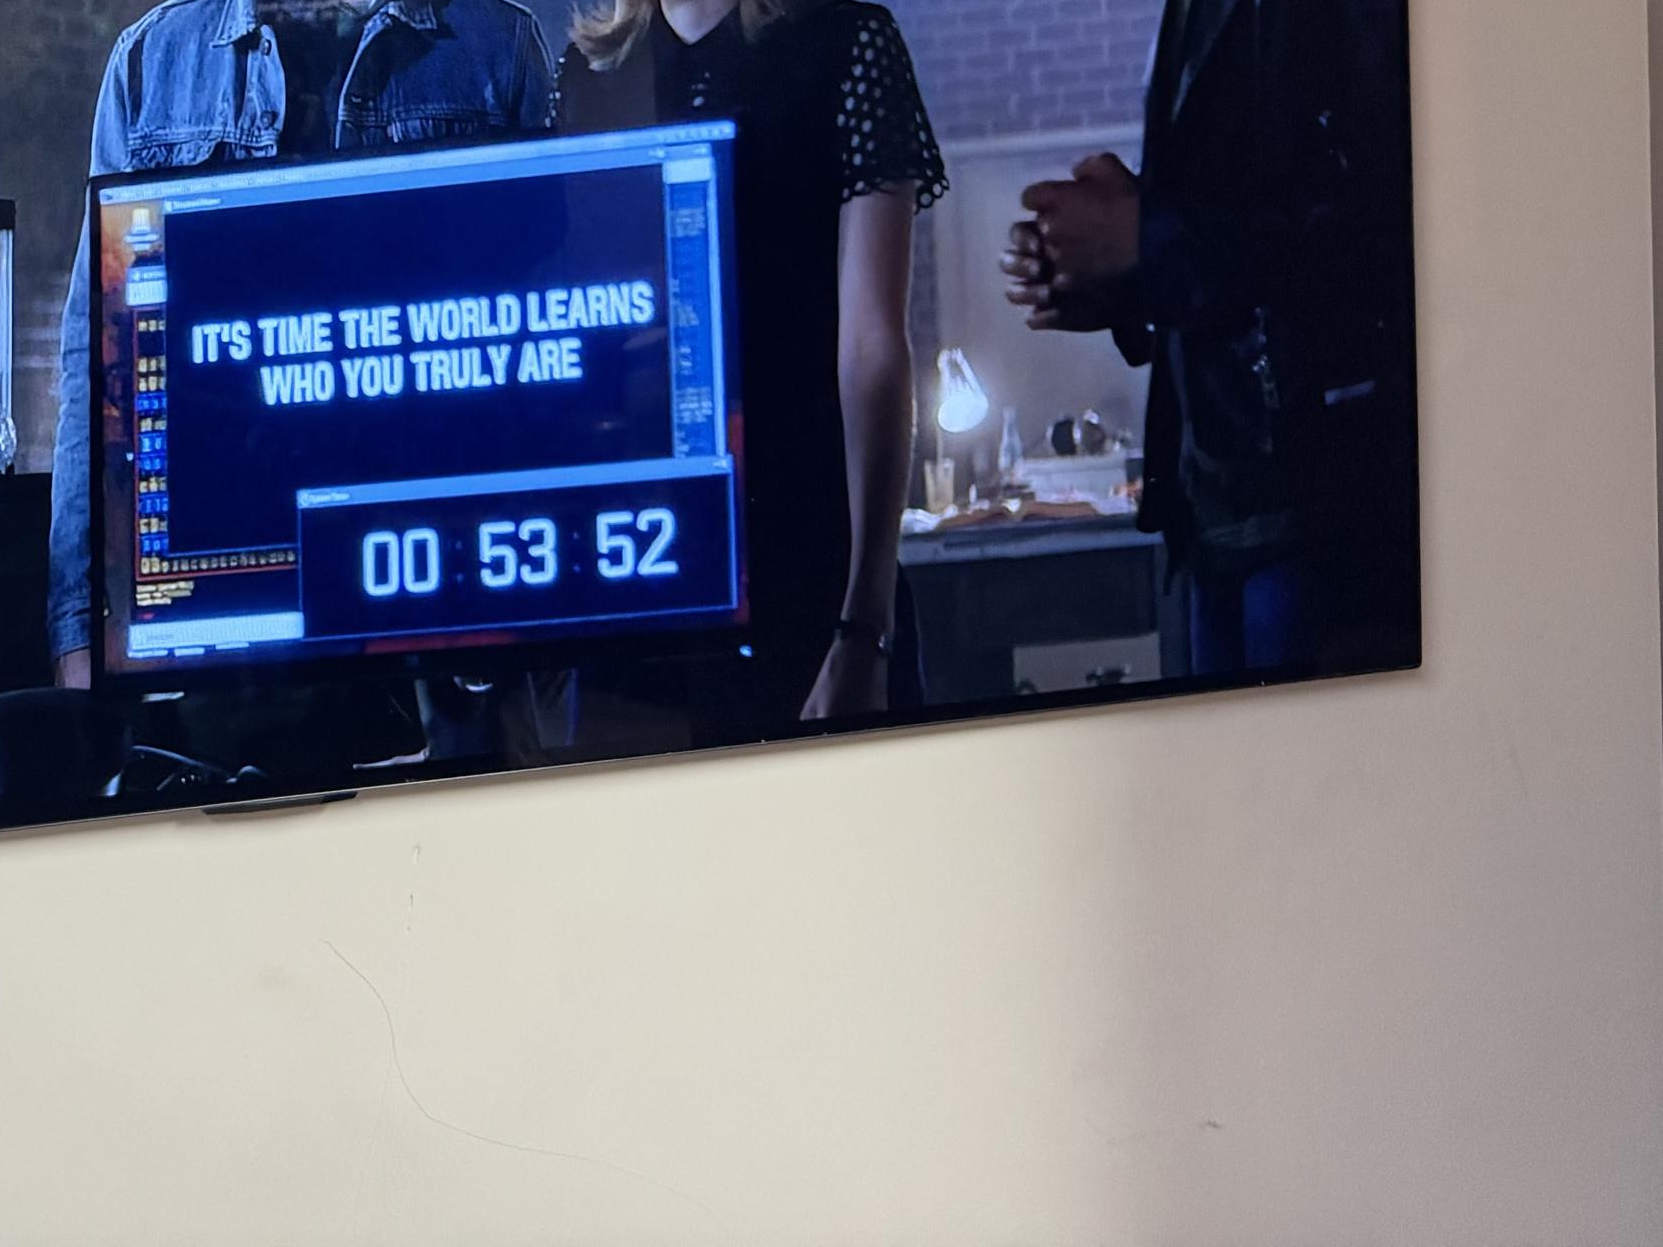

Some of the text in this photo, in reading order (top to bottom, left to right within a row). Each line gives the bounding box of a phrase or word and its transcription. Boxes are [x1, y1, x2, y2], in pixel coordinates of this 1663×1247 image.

[191, 280, 656, 364] IT'S TIME THE WORLD LEARNS
[259, 337, 583, 406] WHO YOU TRULY ARE
